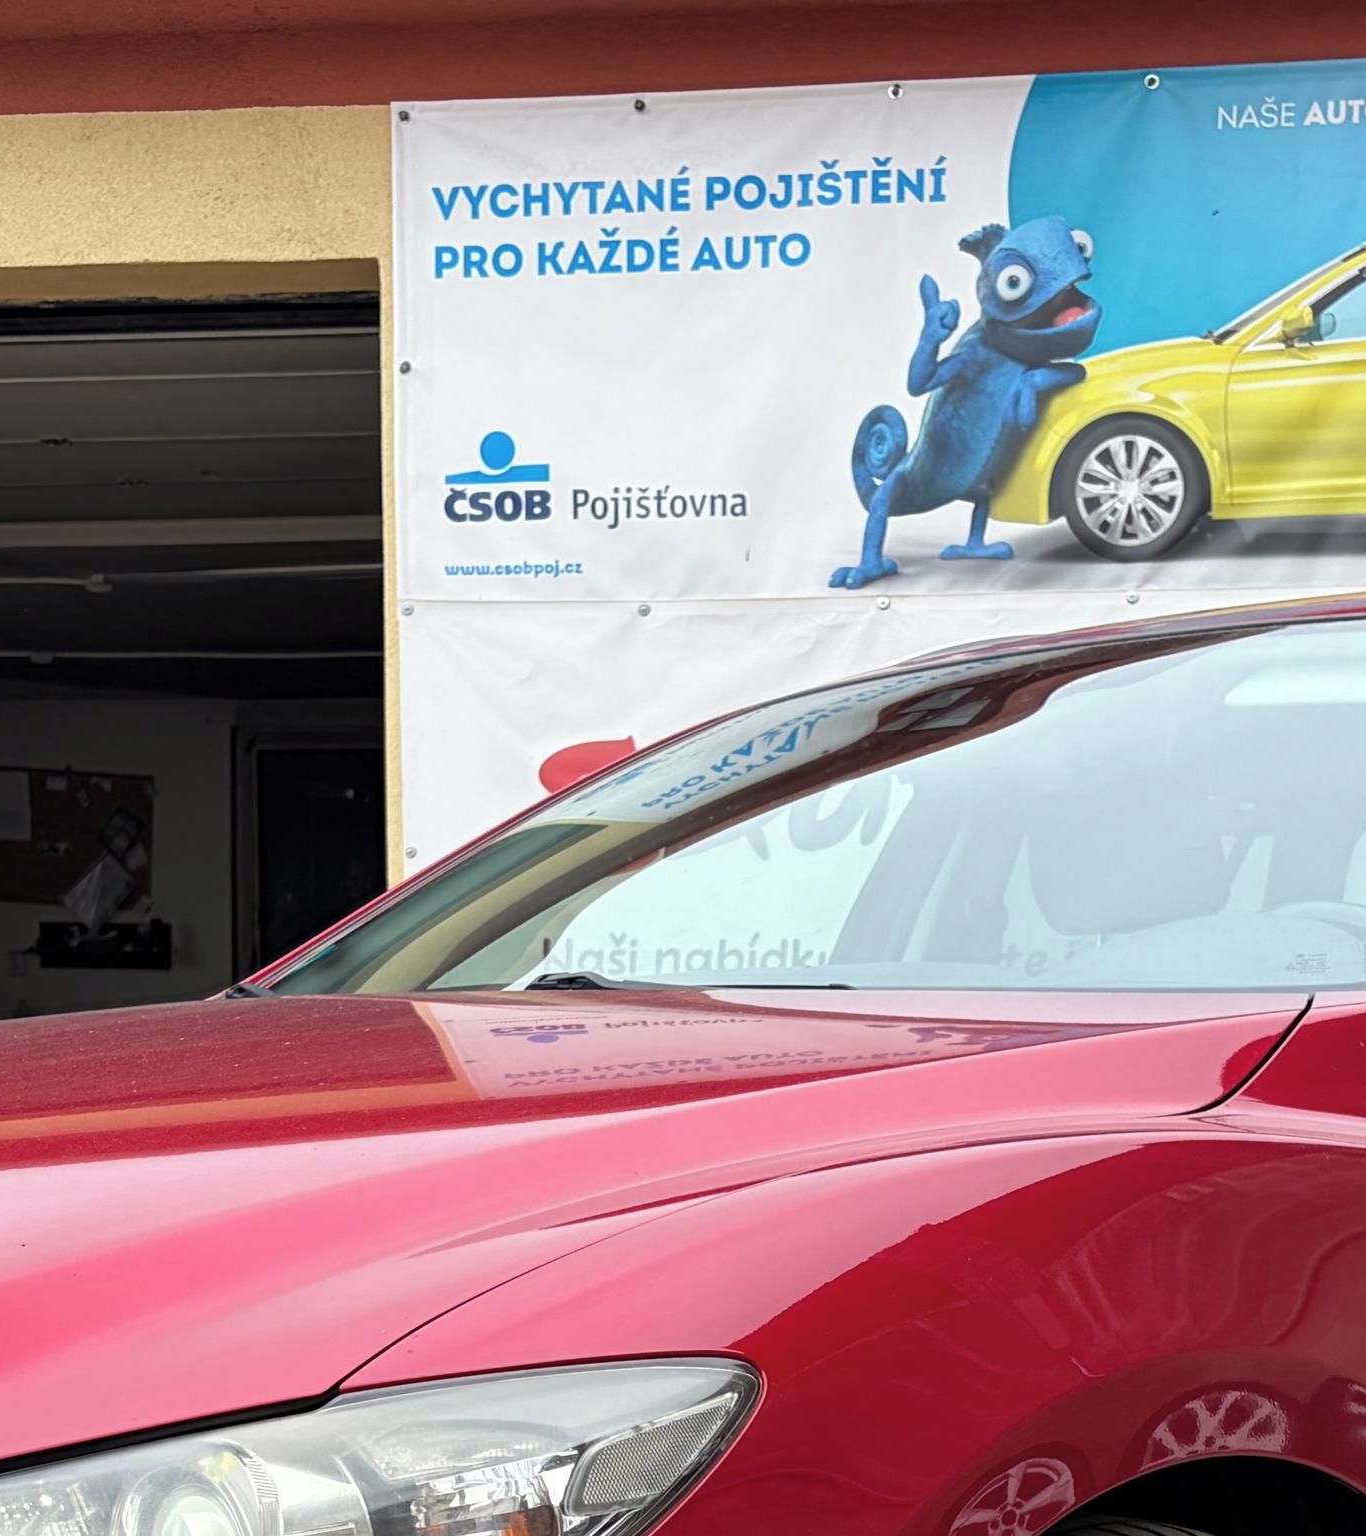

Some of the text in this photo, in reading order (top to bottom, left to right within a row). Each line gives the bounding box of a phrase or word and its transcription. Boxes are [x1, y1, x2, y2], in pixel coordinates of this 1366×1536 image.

[1217, 96, 1296, 130] NAŠE
[432, 155, 947, 221] VYCHYTANÉ POJIŠTĚNÍ
[434, 226, 811, 279] PRO KAŽDÉ AUTO
[443, 484, 748, 529] ČSOB Pojišťovna
[444, 560, 584, 577] www.csobpoj.cz
[542, 931, 639, 978] Naši
